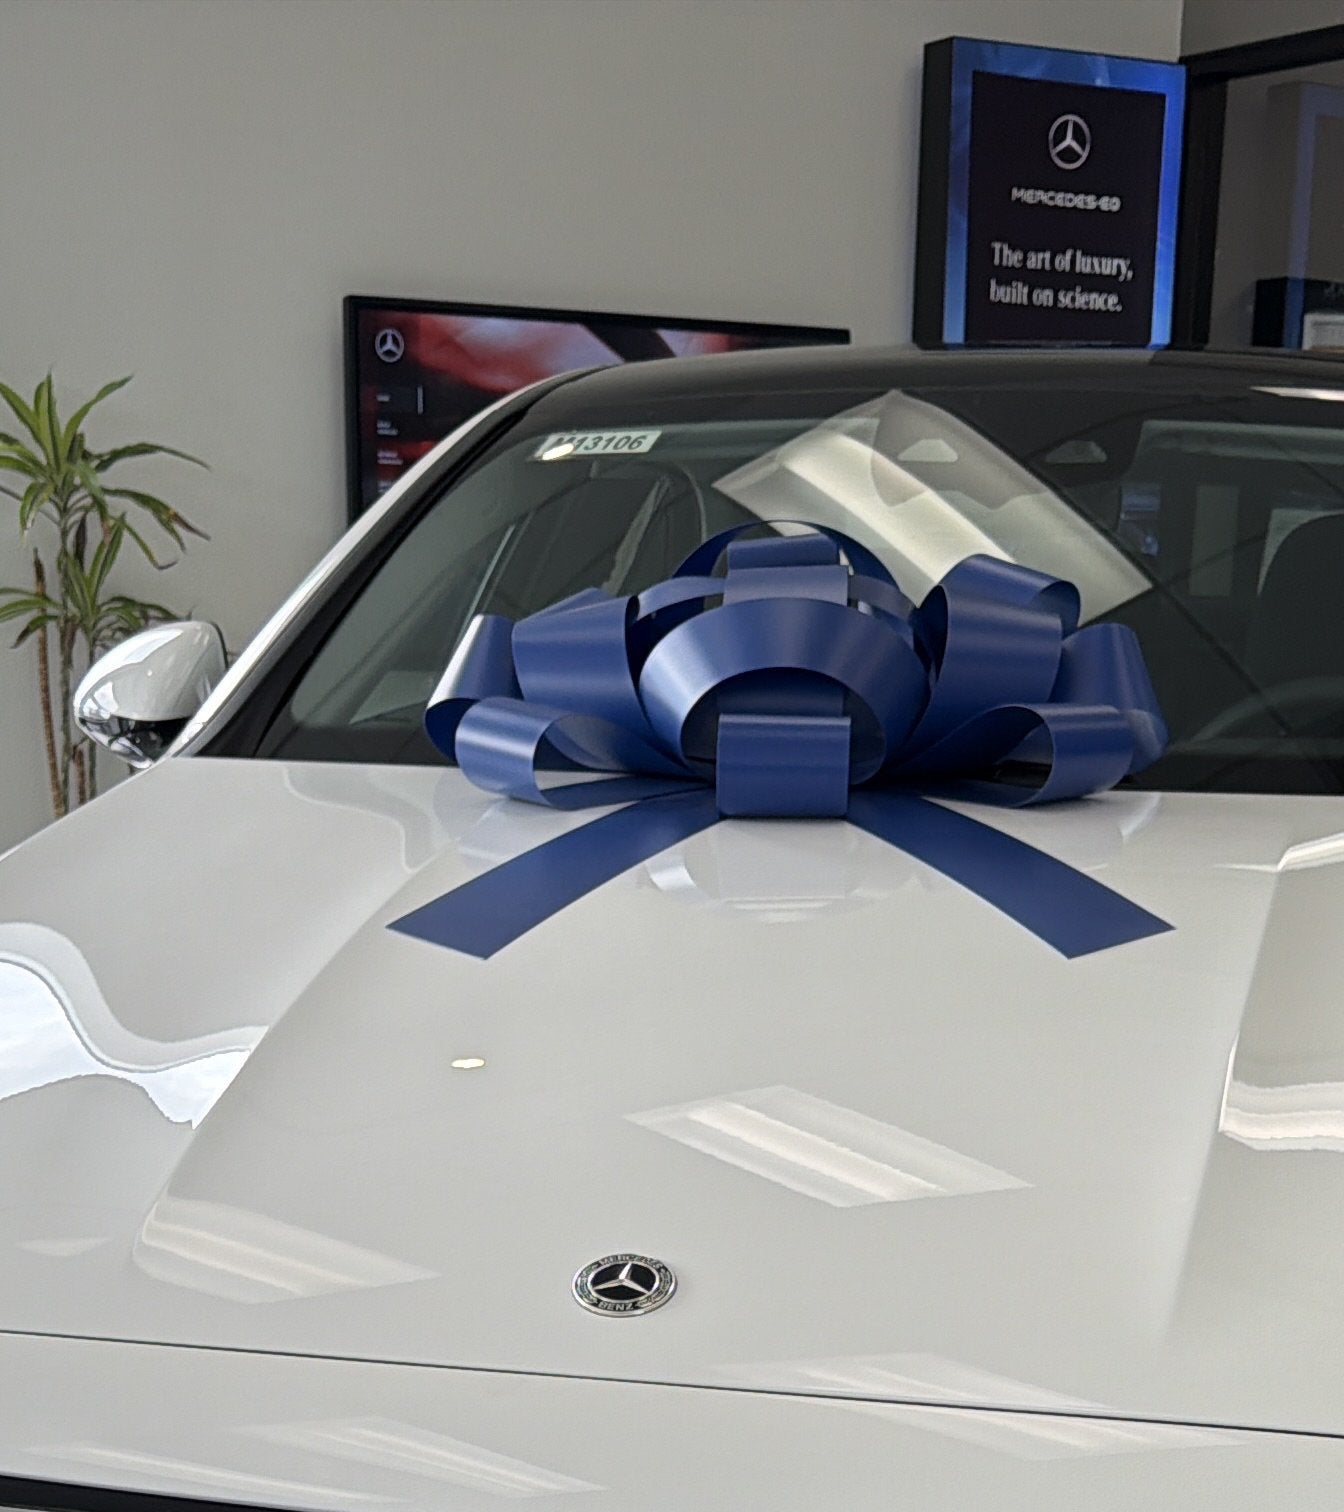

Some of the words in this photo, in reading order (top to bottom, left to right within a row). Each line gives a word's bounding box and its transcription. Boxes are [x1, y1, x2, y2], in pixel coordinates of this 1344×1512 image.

[990, 241, 1024, 269] The
[1026, 250, 1051, 271] art
[1055, 248, 1074, 273] of
[1075, 249, 1133, 282] luxury,
[989, 278, 1029, 306] built
[1032, 287, 1054, 308] on
[1057, 285, 1123, 313] science.
[598, 1301, 635, 1311] BENZ
